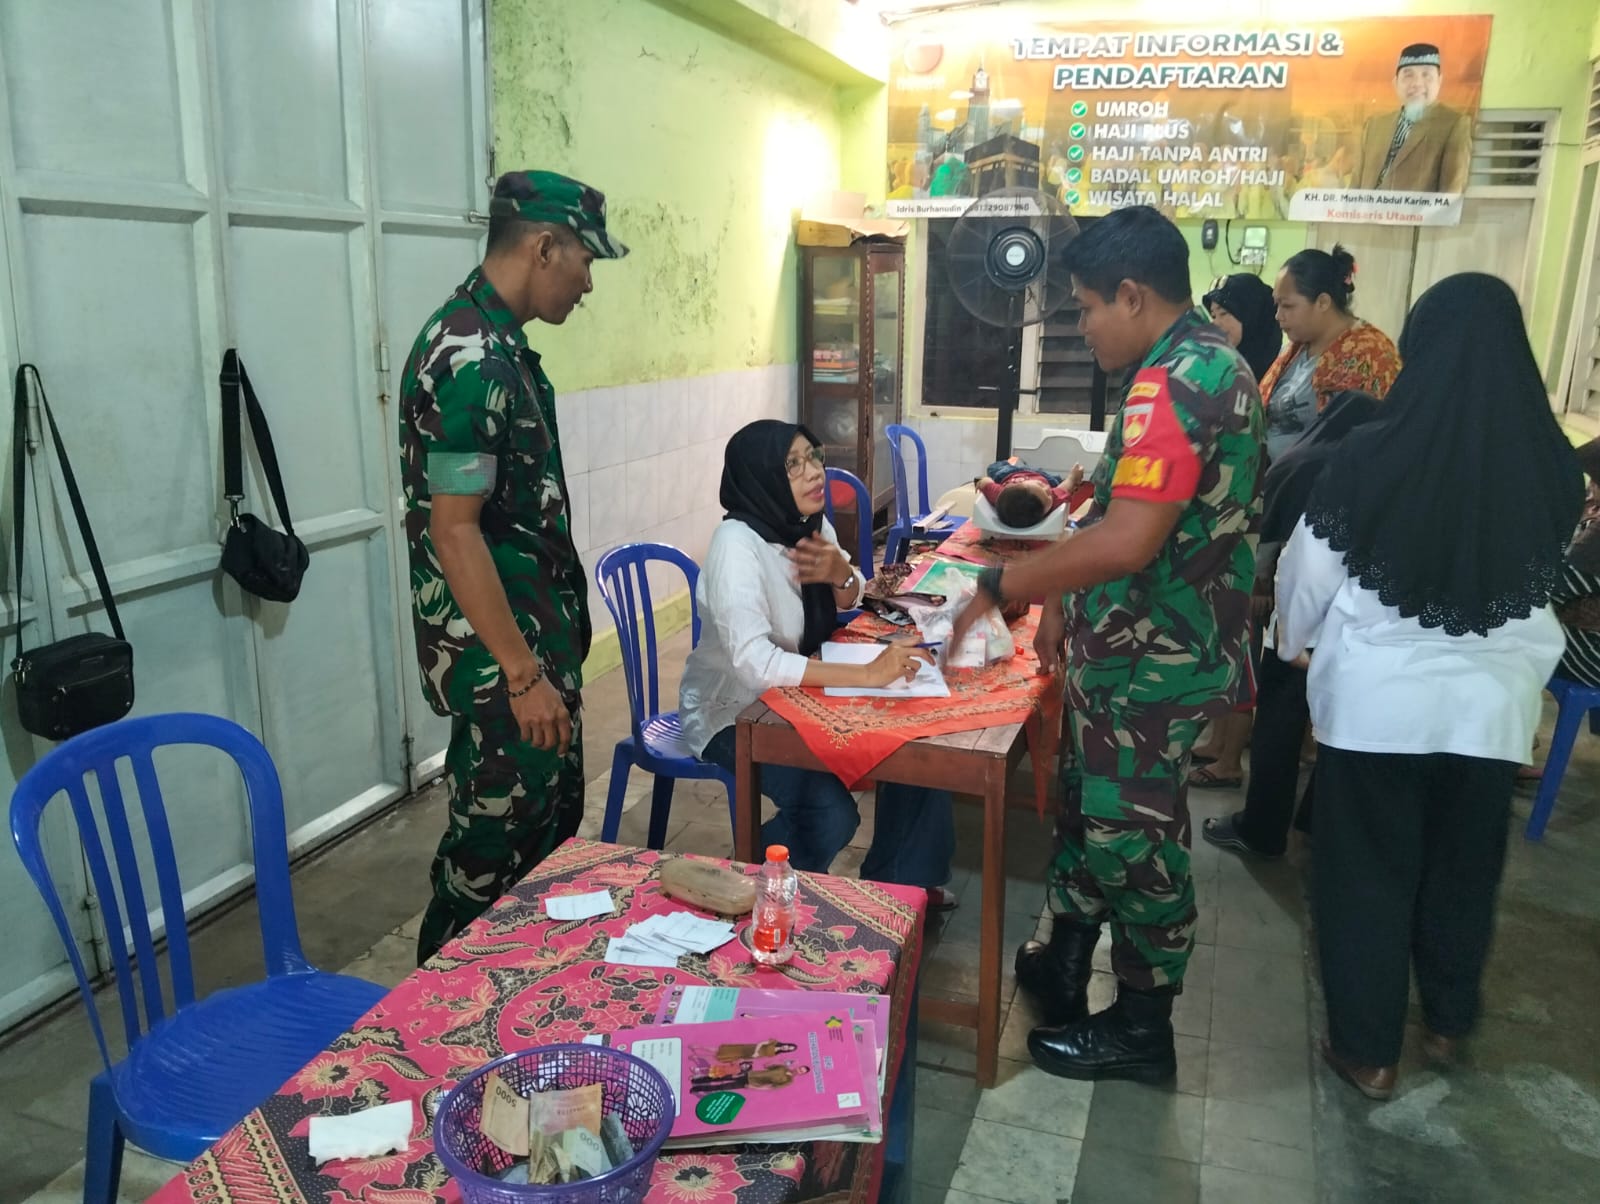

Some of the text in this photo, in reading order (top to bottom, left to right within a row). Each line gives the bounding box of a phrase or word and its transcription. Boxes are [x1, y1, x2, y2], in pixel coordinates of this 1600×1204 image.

[1012, 31, 1342, 57] TEMPAT INFORMASI &
[1055, 64, 1286, 88] PENDAFTARAN
[1096, 101, 1169, 118] UMROH
[1094, 123, 1190, 140] HAJI PLUS
[1092, 146, 1268, 163] HAJI TANPA ANTRI
[1090, 168, 1285, 187] BADAL UMROH/HAJI
[1088, 190, 1224, 208] WISATA HALAL
[1376, 195, 1402, 205] Abdul
[1404, 196, 1432, 207] Karim,
[1434, 198, 1450, 207] MA
[896, 205, 914, 213] Idris
[1327, 208, 1424, 222] Komisaris Utama
[495, 1086, 517, 1108] 5000
